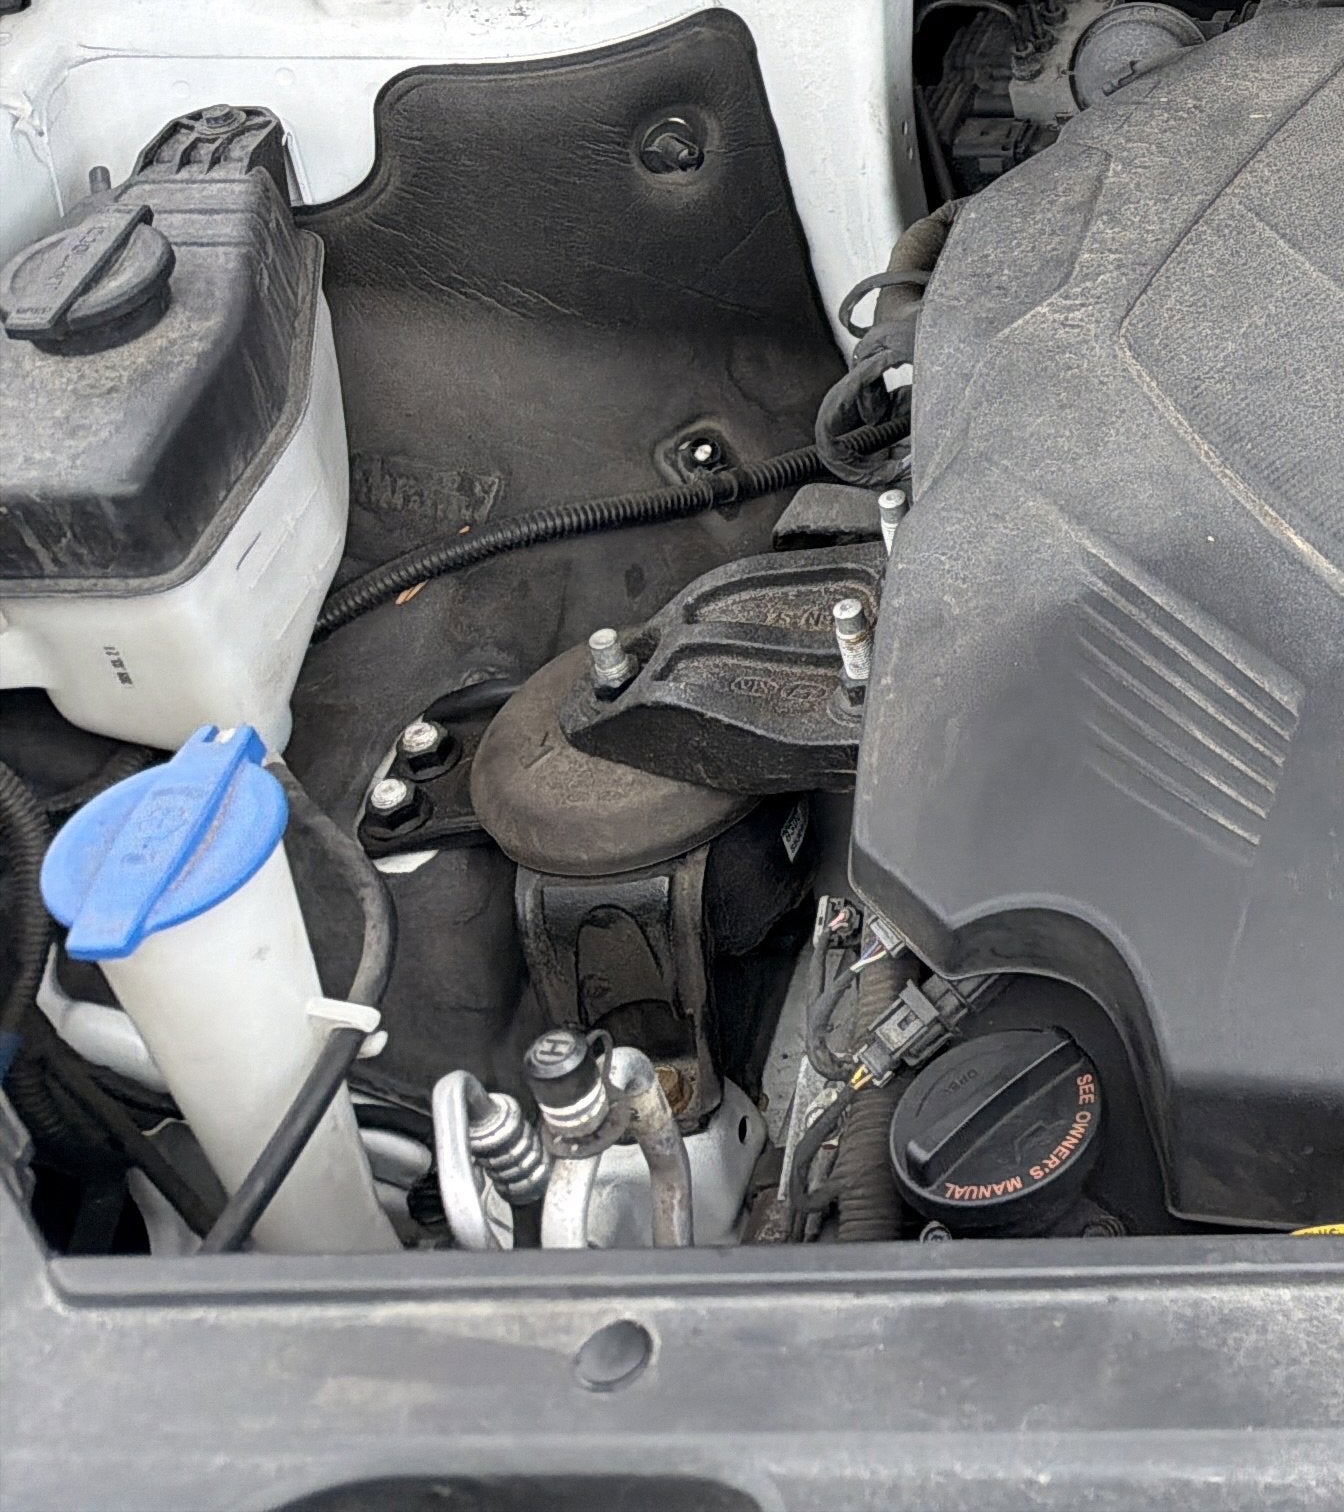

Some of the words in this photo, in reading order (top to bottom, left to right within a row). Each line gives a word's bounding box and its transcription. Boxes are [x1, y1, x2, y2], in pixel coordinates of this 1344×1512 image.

[1076, 1072, 1095, 1106] SEE
[1029, 1111, 1092, 1180] OWNER'S
[944, 1176, 1024, 1200] MANUAL
